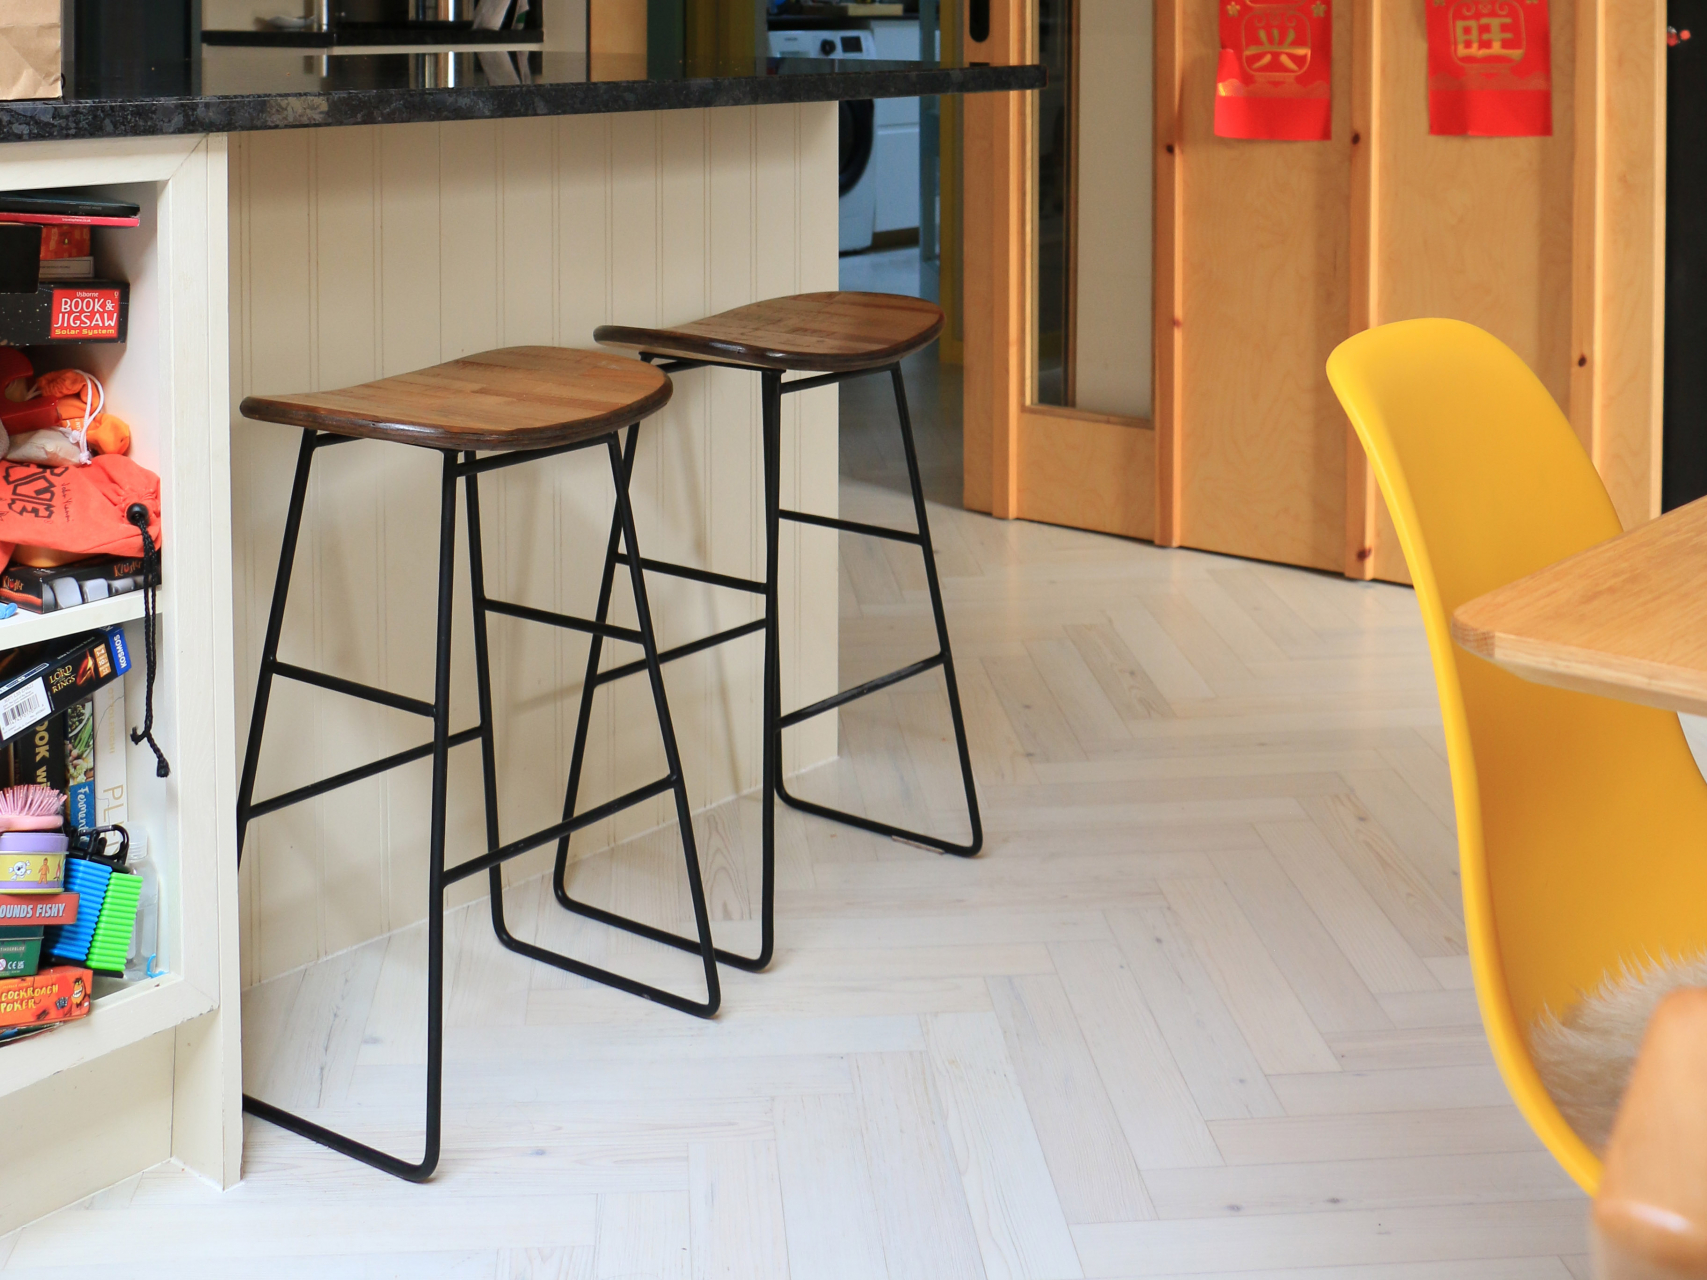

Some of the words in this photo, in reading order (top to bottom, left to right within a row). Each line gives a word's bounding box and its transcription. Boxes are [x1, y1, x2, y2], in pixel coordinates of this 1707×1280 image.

[61, 298, 104, 312] BOOK
[105, 299, 115, 311] &
[53, 313, 118, 327] JIGSAW
[81, 328, 115, 336] System
[113, 634, 128, 669] KOSMOS
[48, 664, 73, 684] LORD
[51, 675, 77, 694] RINGS
[0, 904, 34, 918] OUNDS
[35, 903, 66, 918] FISHY
[1, 984, 59, 1001] COCKROACH
[0, 998, 36, 1014] POKER
